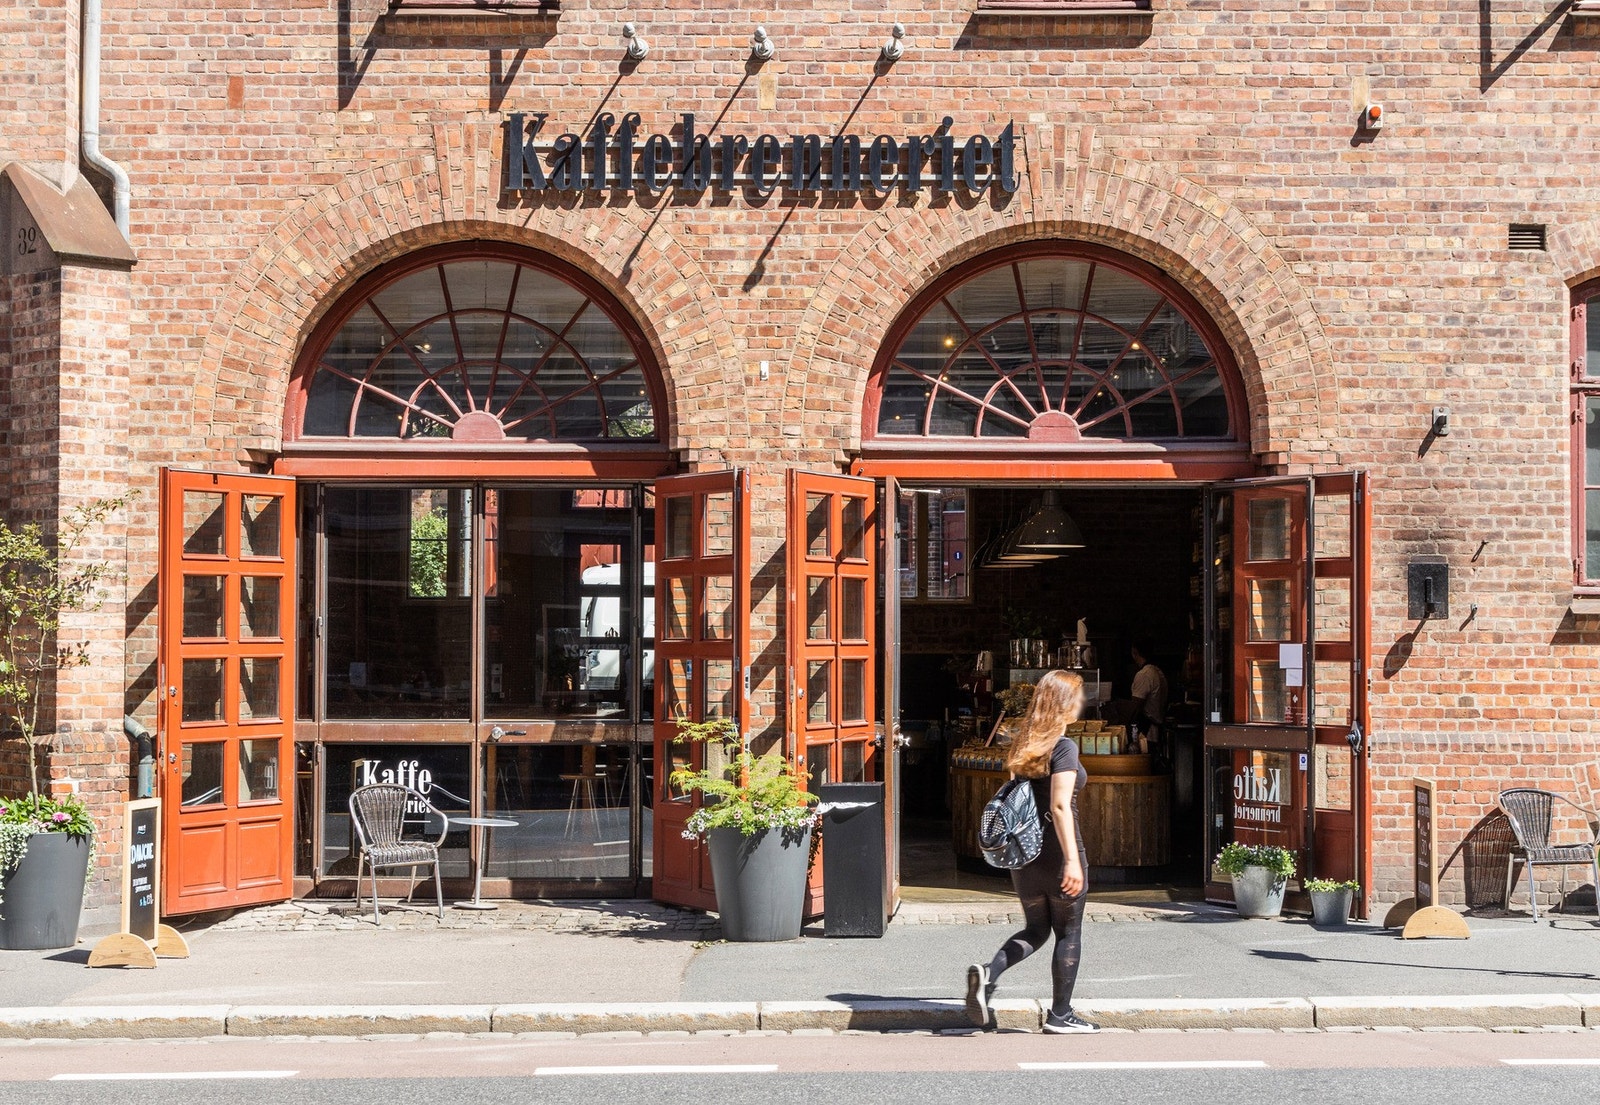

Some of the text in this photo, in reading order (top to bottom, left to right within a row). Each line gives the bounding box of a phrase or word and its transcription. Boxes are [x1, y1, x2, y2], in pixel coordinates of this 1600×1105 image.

[505, 112, 1021, 193] Kaffebrenneriet
[18, 227, 37, 256] 32
[362, 760, 432, 795] Kaffe
